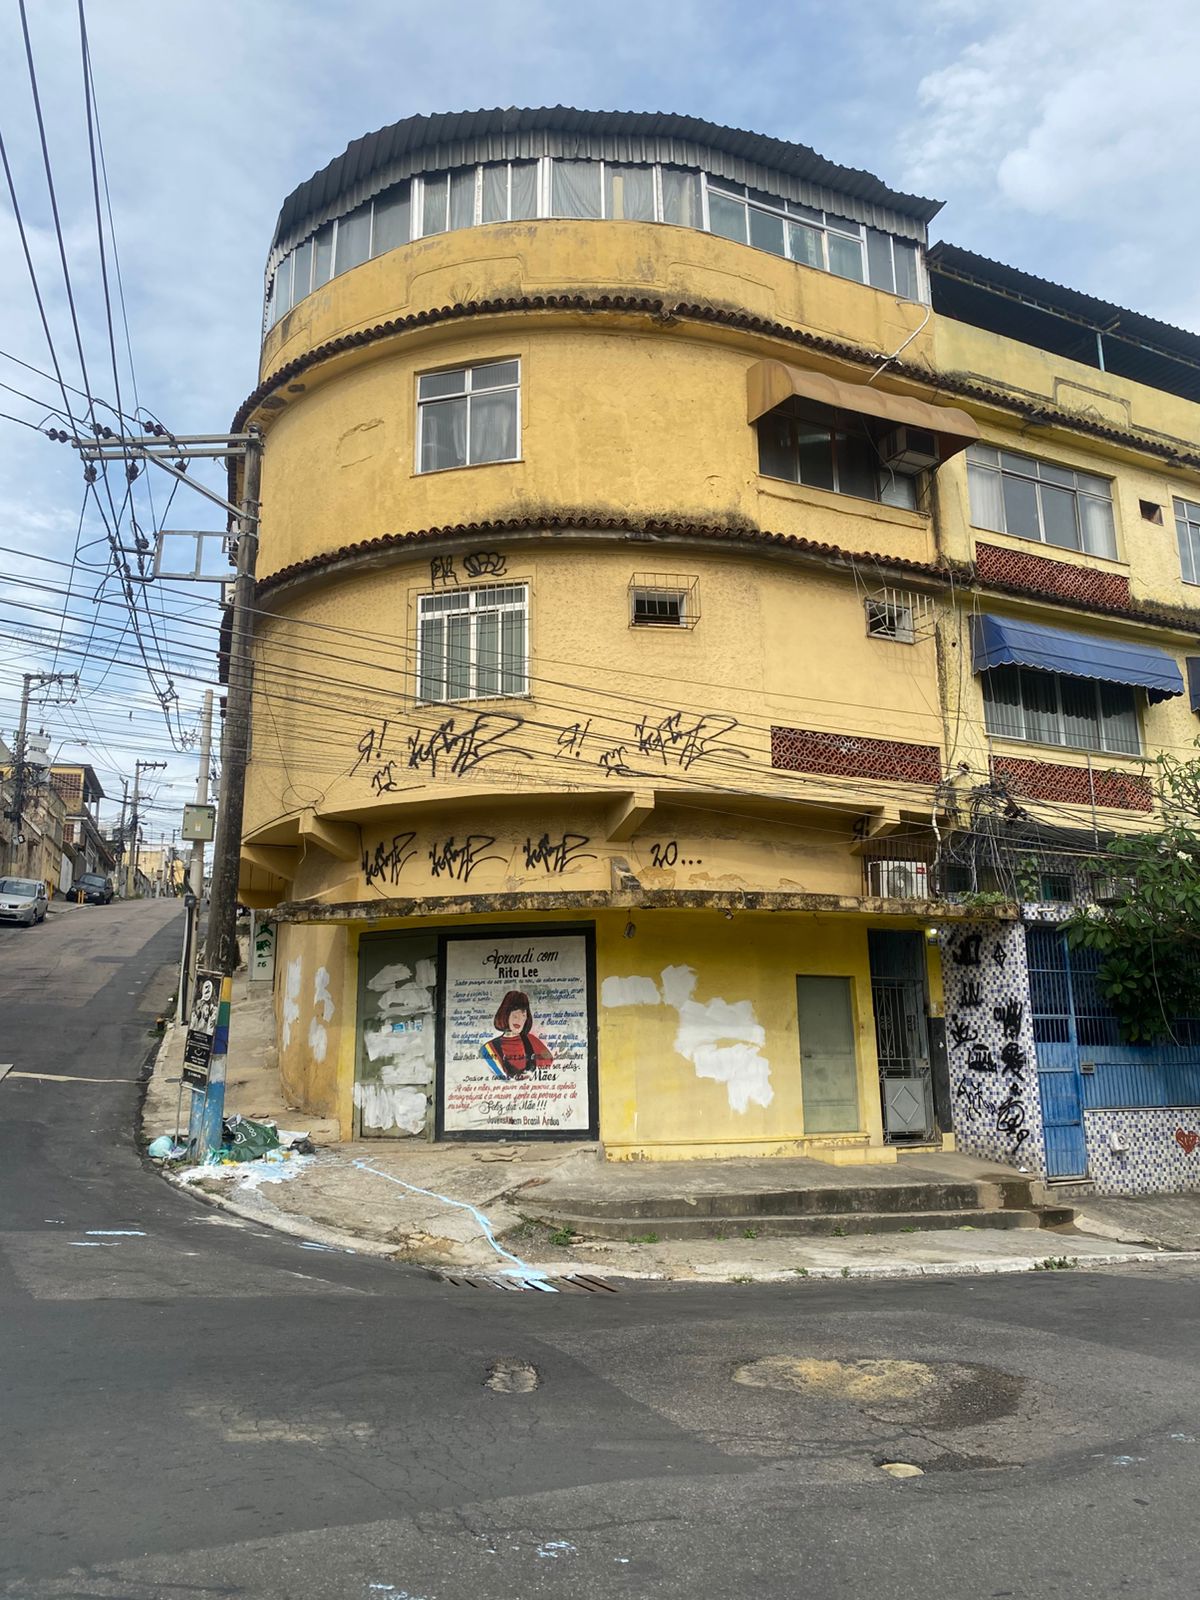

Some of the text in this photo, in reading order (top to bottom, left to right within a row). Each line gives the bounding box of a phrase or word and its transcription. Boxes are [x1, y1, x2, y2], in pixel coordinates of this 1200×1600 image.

[482, 947, 559, 969] Aprendi com
[498, 966, 539, 979] Rita Lee
[529, 1070, 559, 1082] Mães
